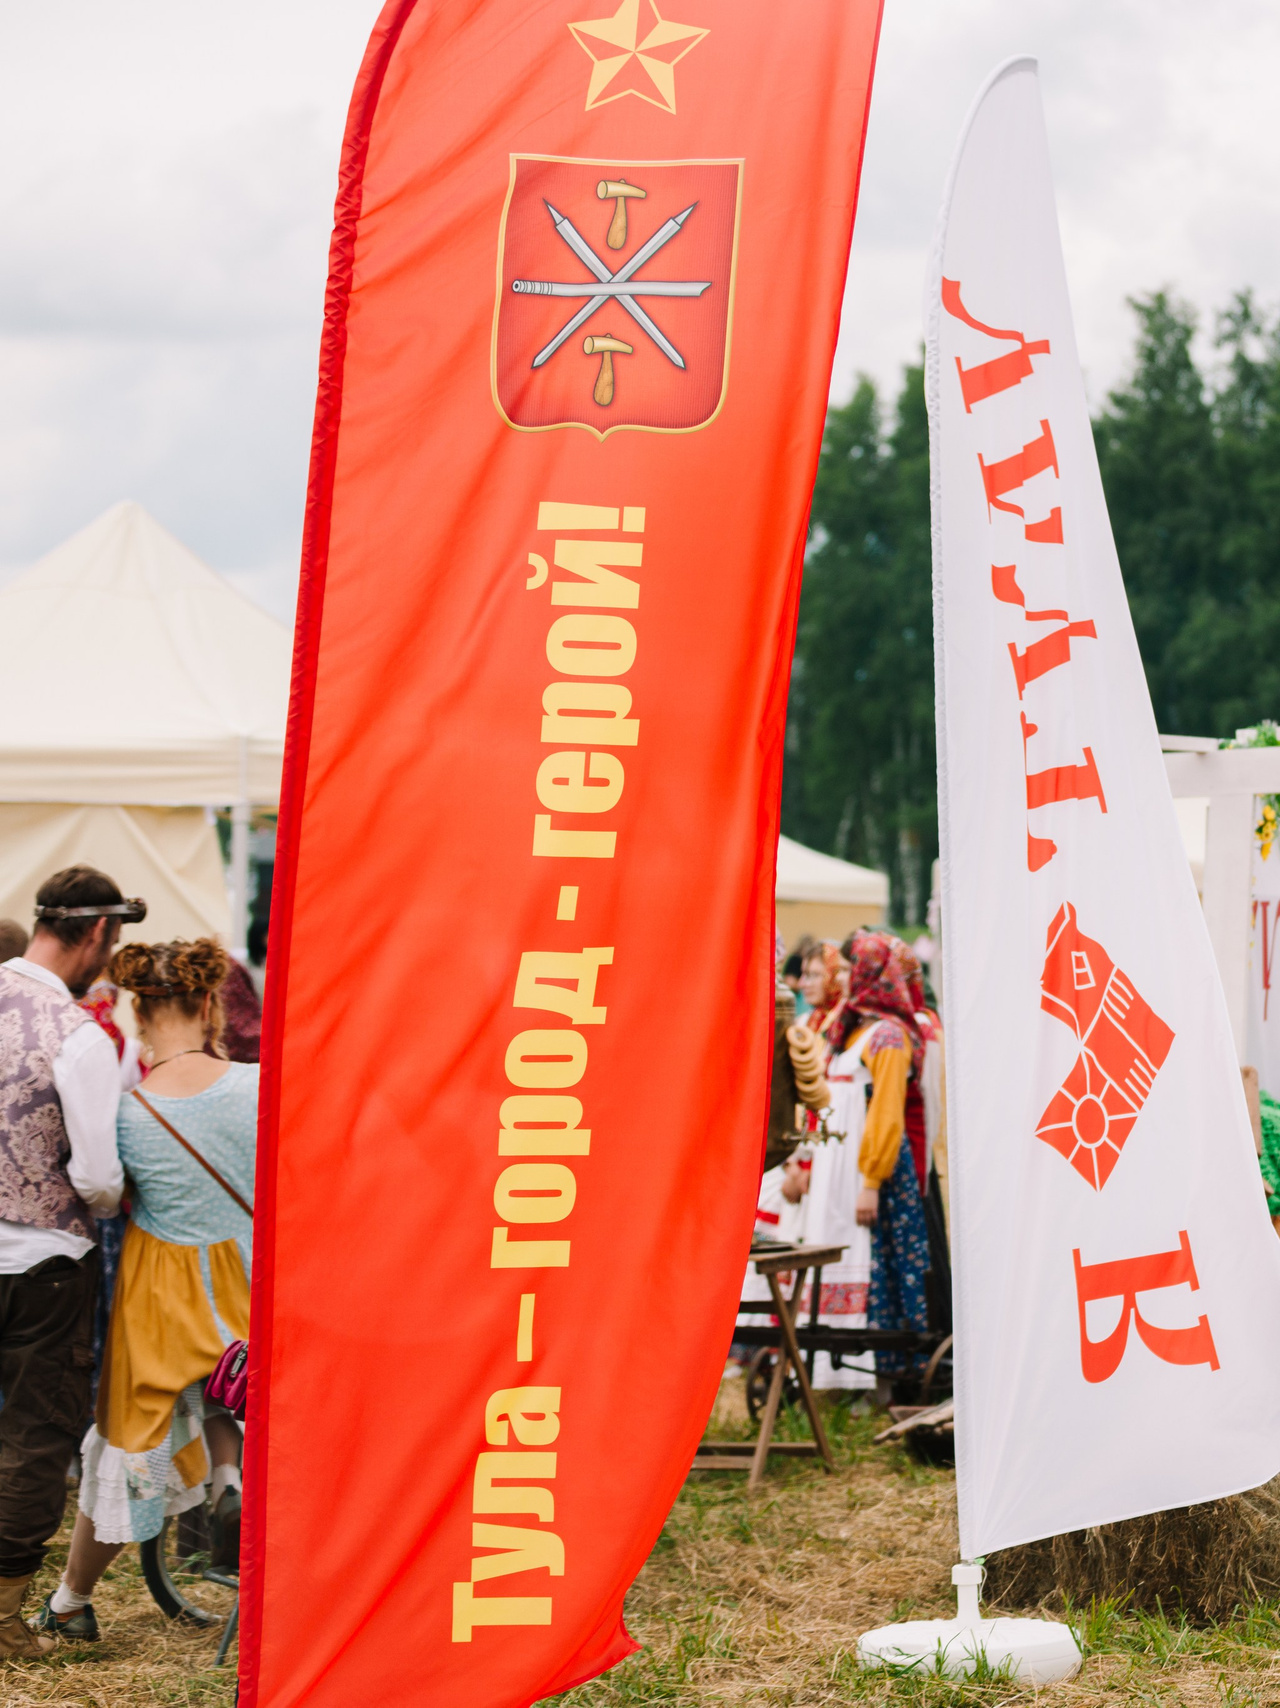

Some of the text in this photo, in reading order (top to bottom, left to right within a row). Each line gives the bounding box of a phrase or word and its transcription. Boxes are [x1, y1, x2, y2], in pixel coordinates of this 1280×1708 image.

[526, 502, 646, 859] герой!
[490, 946, 615, 1269] город
[1072, 1229, 1221, 1385] Я
[451, 1386, 565, 1643] Тула
